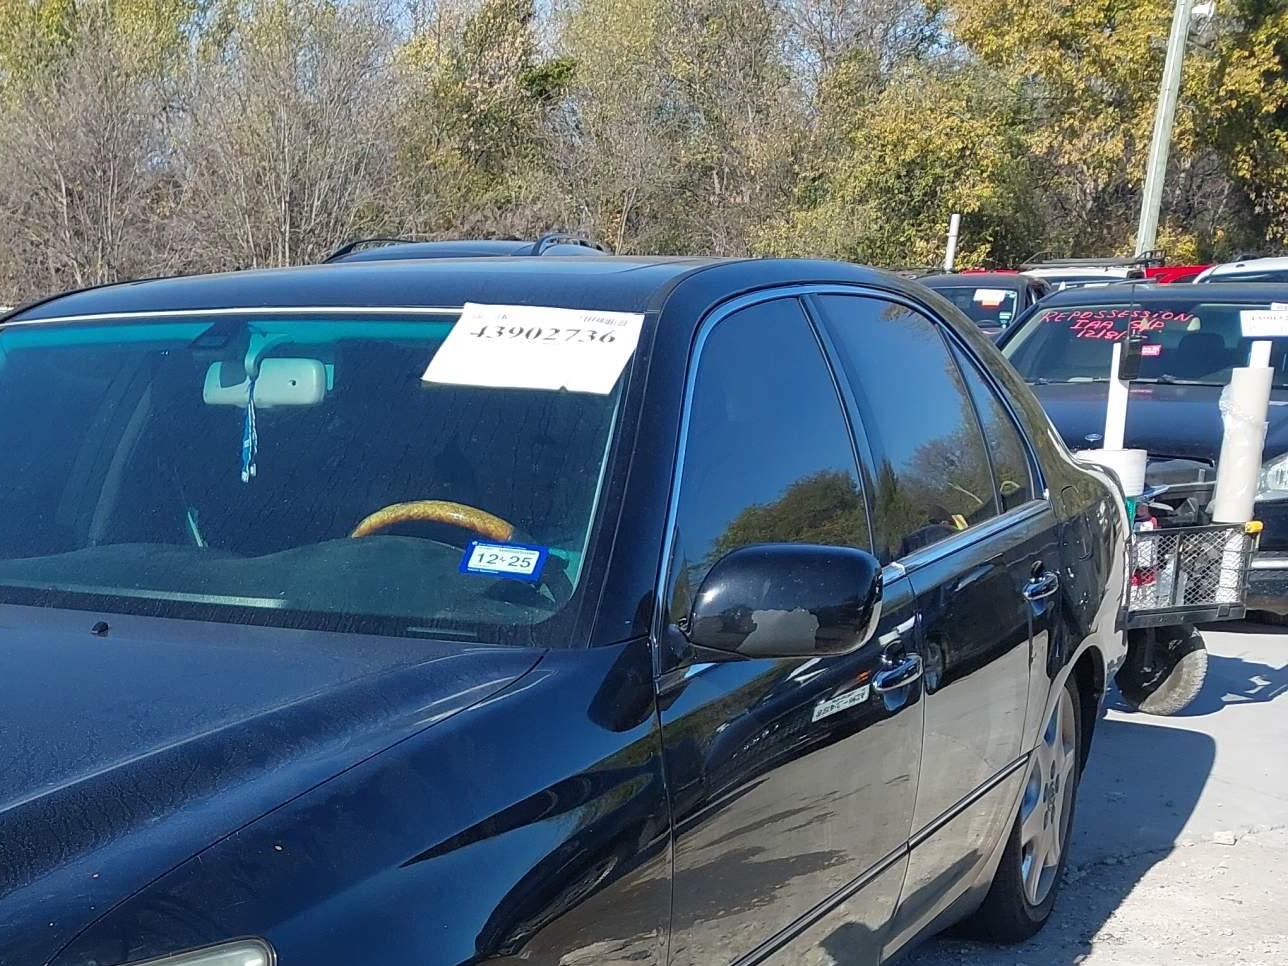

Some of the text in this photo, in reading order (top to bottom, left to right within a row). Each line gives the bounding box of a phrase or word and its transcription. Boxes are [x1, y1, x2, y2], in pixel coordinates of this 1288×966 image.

[1041, 310, 1194, 323] REPOSSESSION
[1070, 319, 1114, 330] IAA
[469, 325, 617, 344] 43902736
